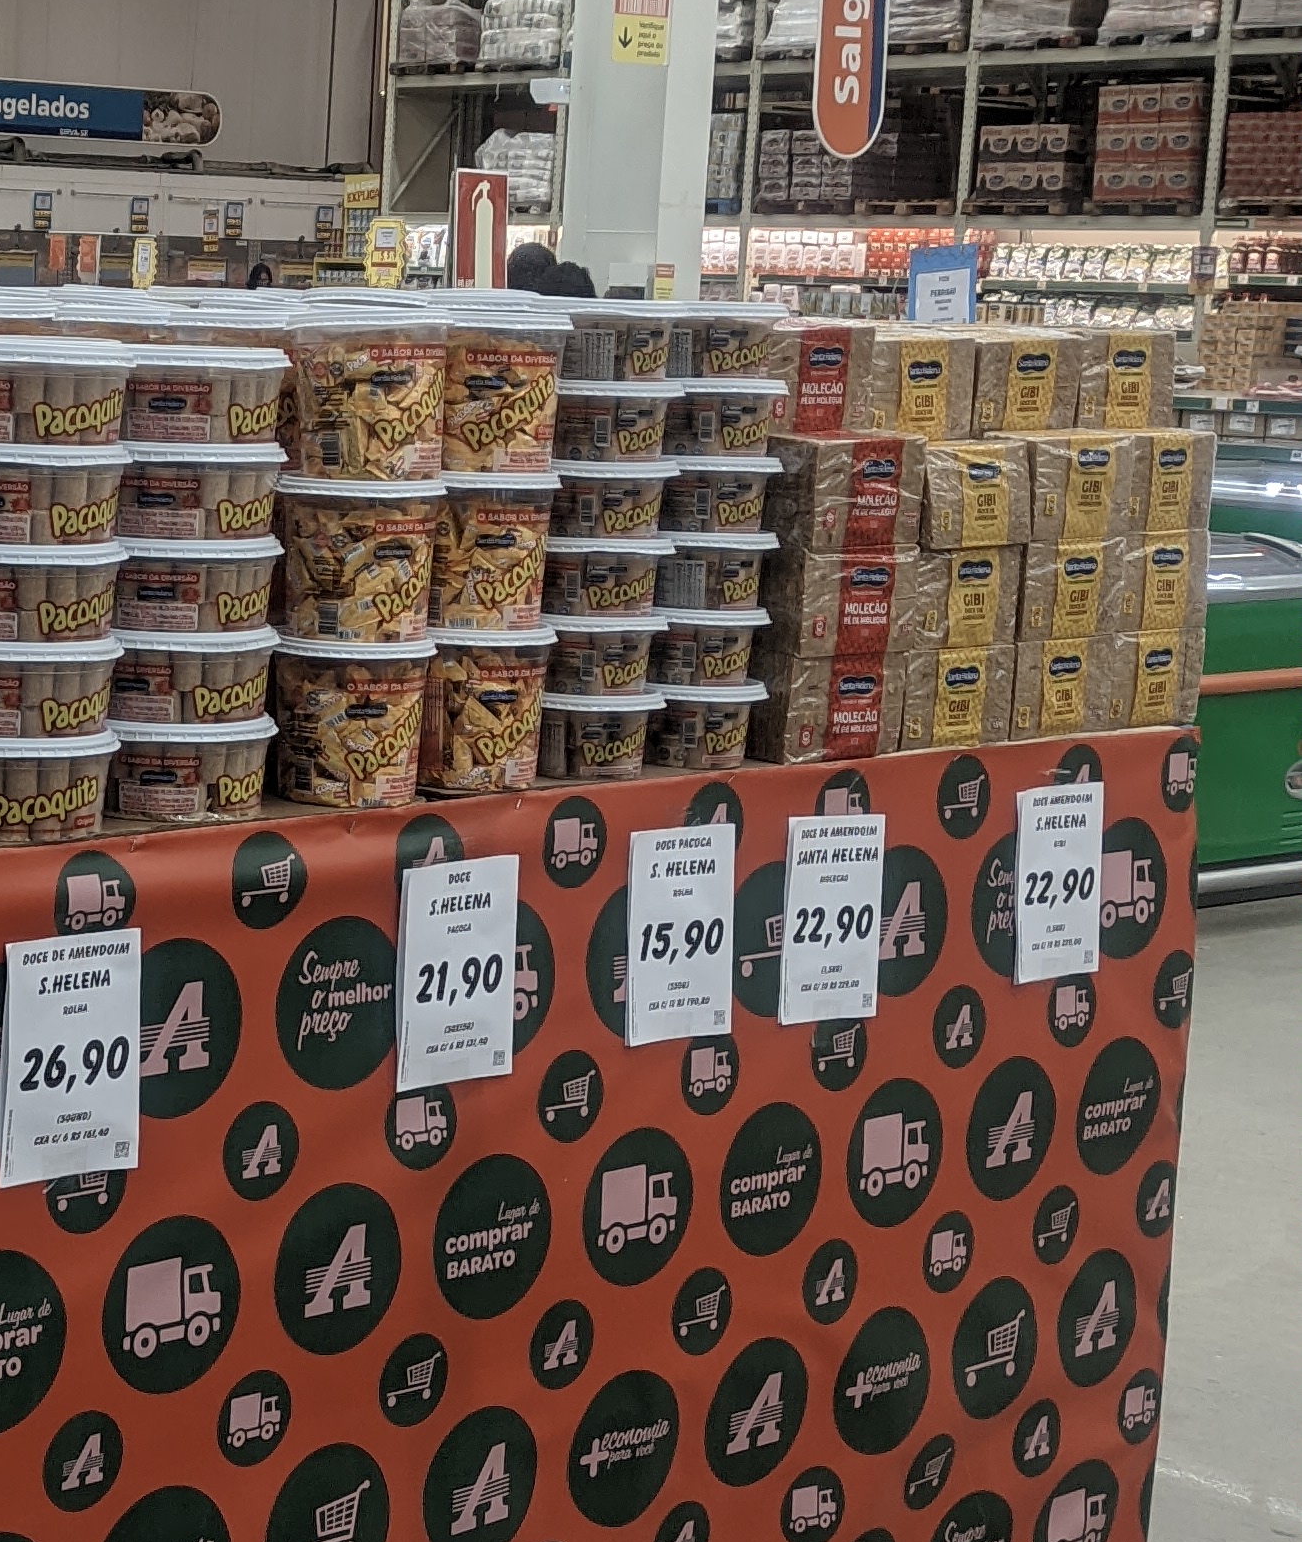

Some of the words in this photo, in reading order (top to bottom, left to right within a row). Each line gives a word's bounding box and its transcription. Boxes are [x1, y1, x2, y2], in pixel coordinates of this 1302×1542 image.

[819, 827, 829, 838] DE
[830, 825, 878, 838] AMENDOIM
[1035, 813, 1087, 831] S.HELENA
[678, 837, 712, 850] PACOCA
[797, 849, 828, 866] SANTA
[831, 846, 879, 863] HELENA
[448, 871, 472, 885] DOCE
[650, 862, 661, 879] S.
[665, 858, 716, 878] HELENA
[1024, 866, 1095, 909] 22,90
[429, 892, 491, 916] S.HELENA
[793, 903, 874, 949] 22,90
[640, 917, 724, 966] 15,90
[22, 952, 49, 966] DOCE
[52, 949, 65, 962] DE
[68, 942, 130, 960] AMENDOIM
[38, 969, 111, 996] S.HELENA
[416, 953, 503, 1006] 21,90
[19, 1035, 130, 1095] 26,90
[37, 1297, 52, 1319] de
